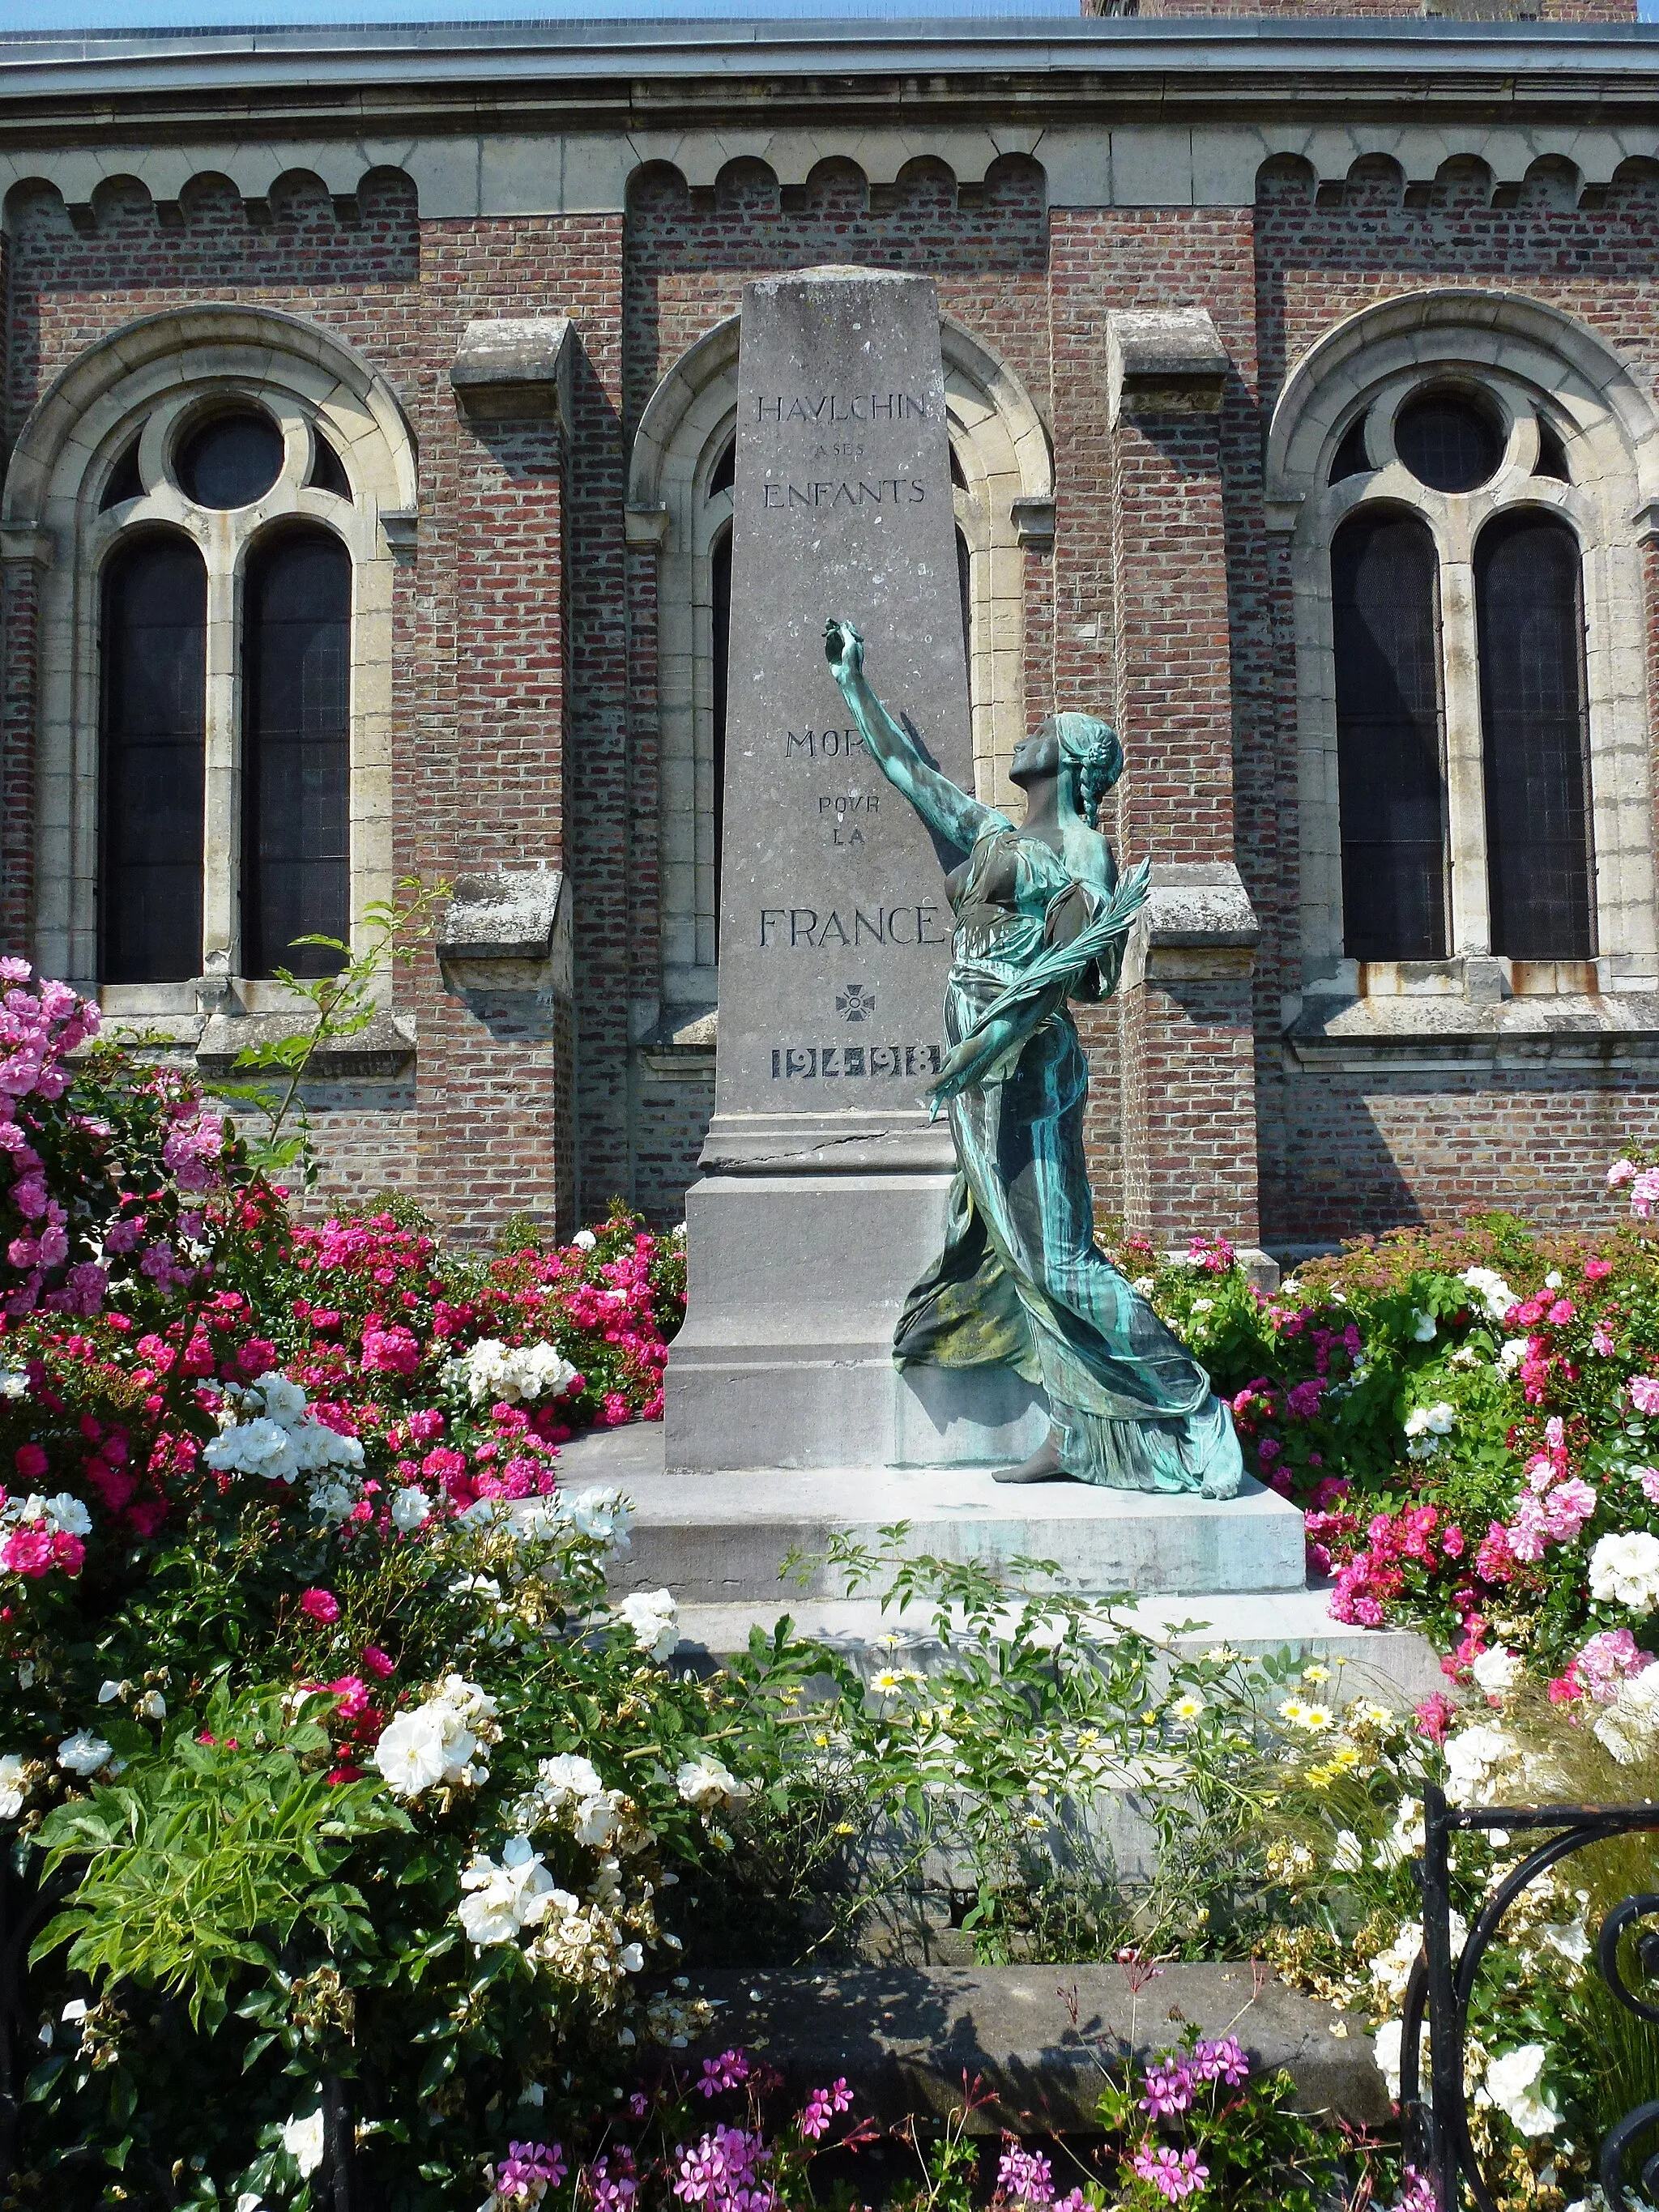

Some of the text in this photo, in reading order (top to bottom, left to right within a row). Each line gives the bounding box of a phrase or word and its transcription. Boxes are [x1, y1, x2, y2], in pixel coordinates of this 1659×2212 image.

[757, 394, 927, 422] HAVLCHIN
[834, 441, 864, 456] SES
[763, 479, 925, 508] ENFANTS
[819, 796, 880, 813] POVR
[833, 828, 865, 846] LA
[759, 906, 945, 947] FRANCE
[772, 1045, 940, 1078] 1914-1918
